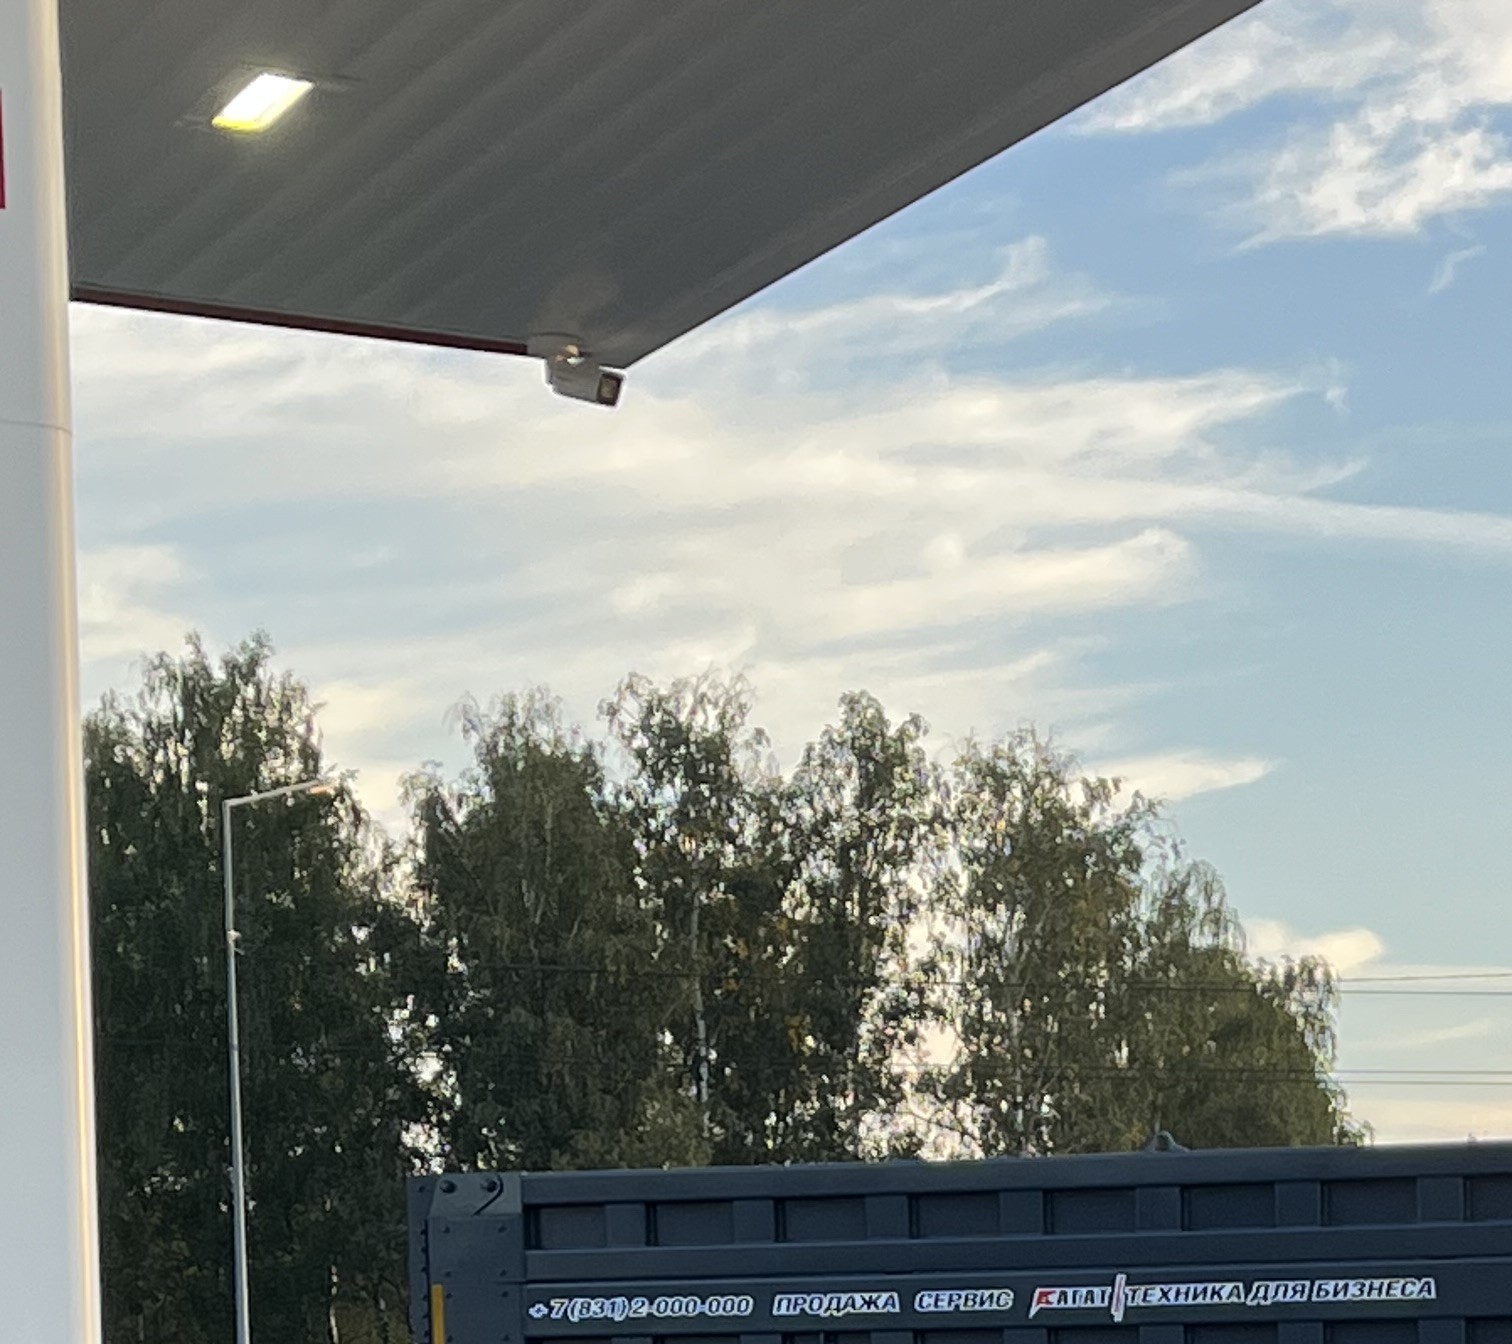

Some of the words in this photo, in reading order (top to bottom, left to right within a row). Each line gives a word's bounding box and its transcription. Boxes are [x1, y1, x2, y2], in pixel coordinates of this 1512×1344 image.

[774, 1292, 900, 1317] ПРОДАЖА
[914, 1289, 1014, 1312] СЕРВИС
[1127, 1282, 1245, 1306] ТЕХНИКА
[1247, 1280, 1310, 1305] ДЛЯ
[1312, 1278, 1436, 1301] БИЗНЕСА
